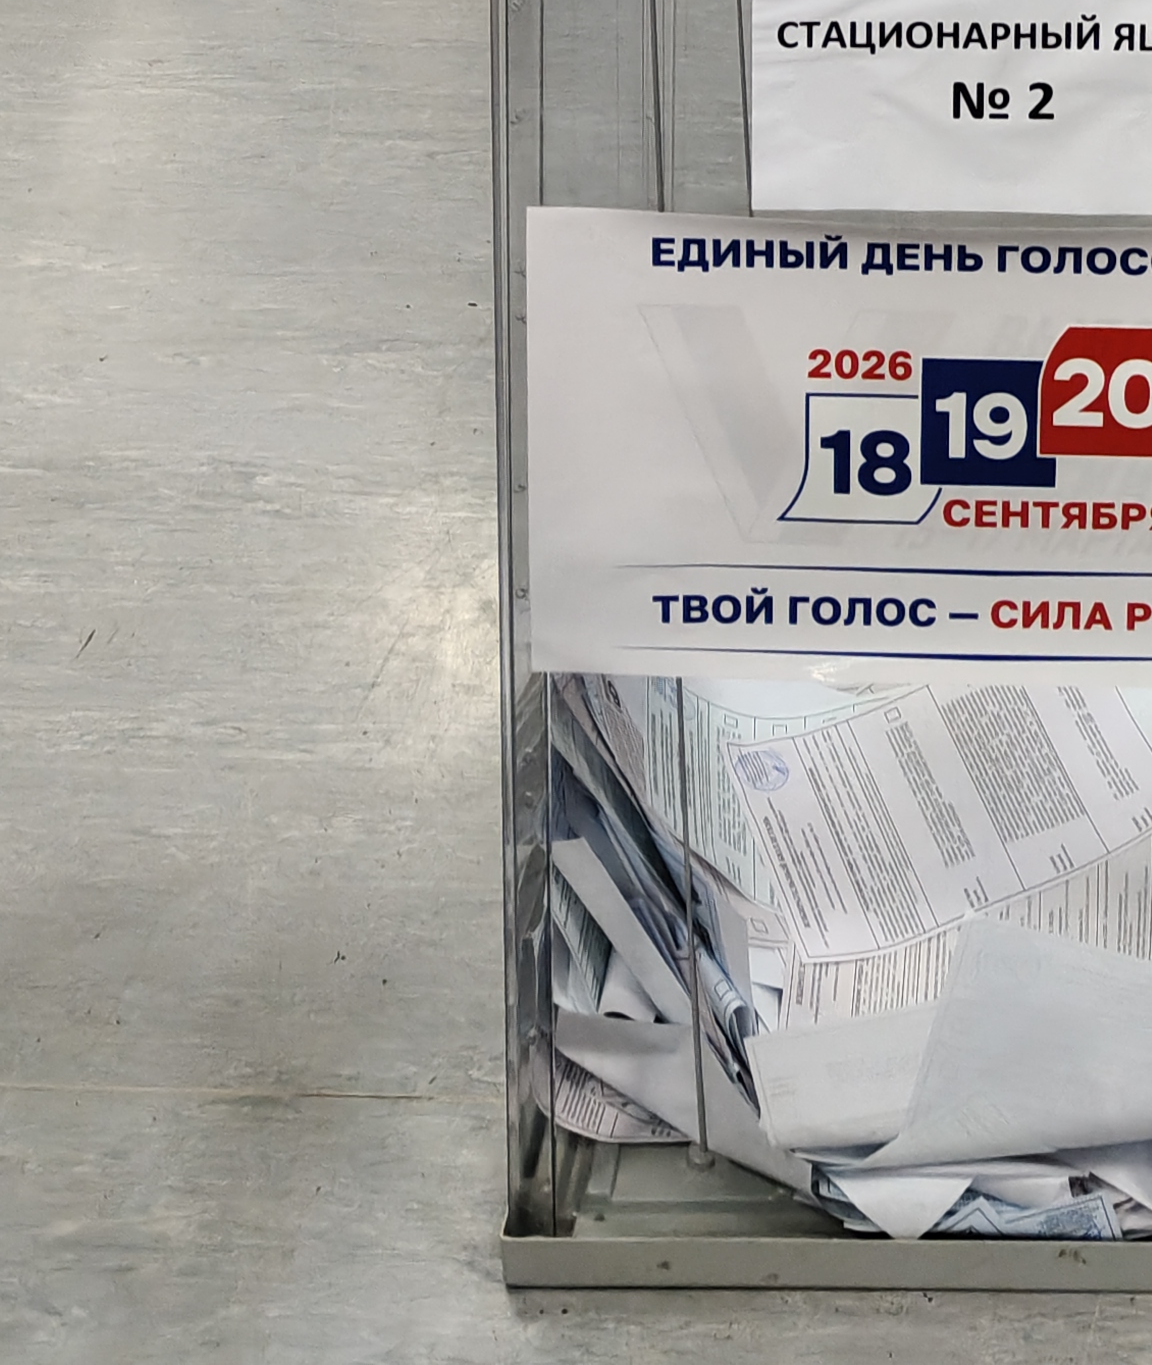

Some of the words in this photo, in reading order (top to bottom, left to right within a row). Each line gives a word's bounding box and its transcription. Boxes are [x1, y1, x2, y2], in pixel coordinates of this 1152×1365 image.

[777, 14, 1101, 55] СТАЦИОНАРНЫЙ
[952, 81, 1010, 120] №
[1028, 82, 1055, 120] 2
[651, 233, 848, 273] ЕДИНЫЙ
[861, 241, 984, 276] ДЕНЬ
[807, 348, 913, 382] 2026
[935, 392, 1028, 460] 19
[819, 429, 912, 497] 18
[652, 587, 774, 625] ТВОЙ
[788, 595, 937, 628] ГОЛОС
[990, 599, 1113, 631] СИЛА
